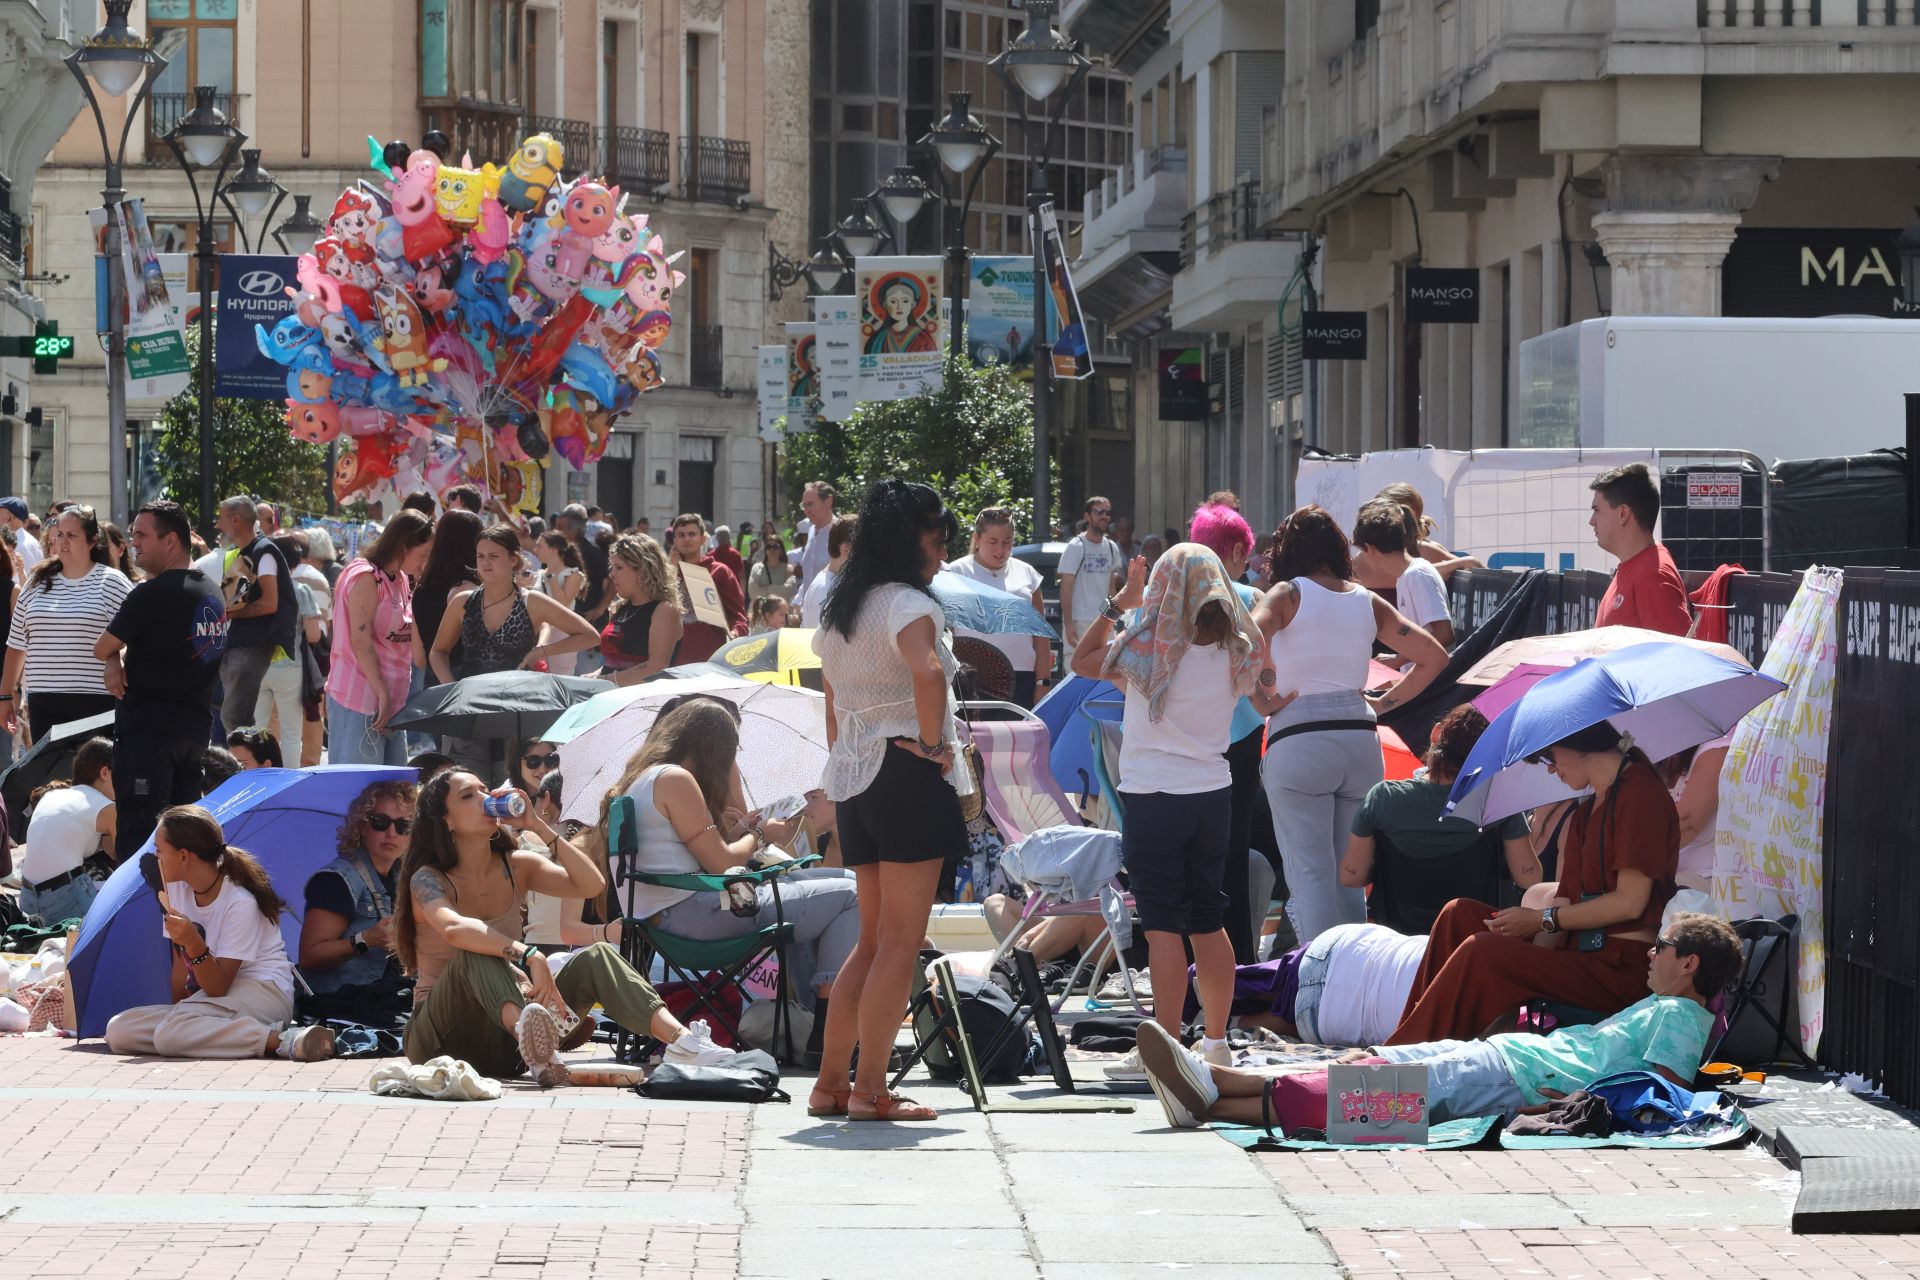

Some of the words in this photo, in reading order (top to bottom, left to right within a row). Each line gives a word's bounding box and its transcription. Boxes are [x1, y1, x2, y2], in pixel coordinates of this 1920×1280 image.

[1801, 246, 1907, 287] MA
[1411, 287, 1474, 299] MANGO
[243, 313, 275, 321] Hyupersa
[1306, 328, 1362, 339] MANGO
[859, 355, 878, 369] 25
[882, 354, 943, 364] VALLADOLID
[1690, 486, 1739, 494] BLAPE
[196, 620, 230, 637] NASA
